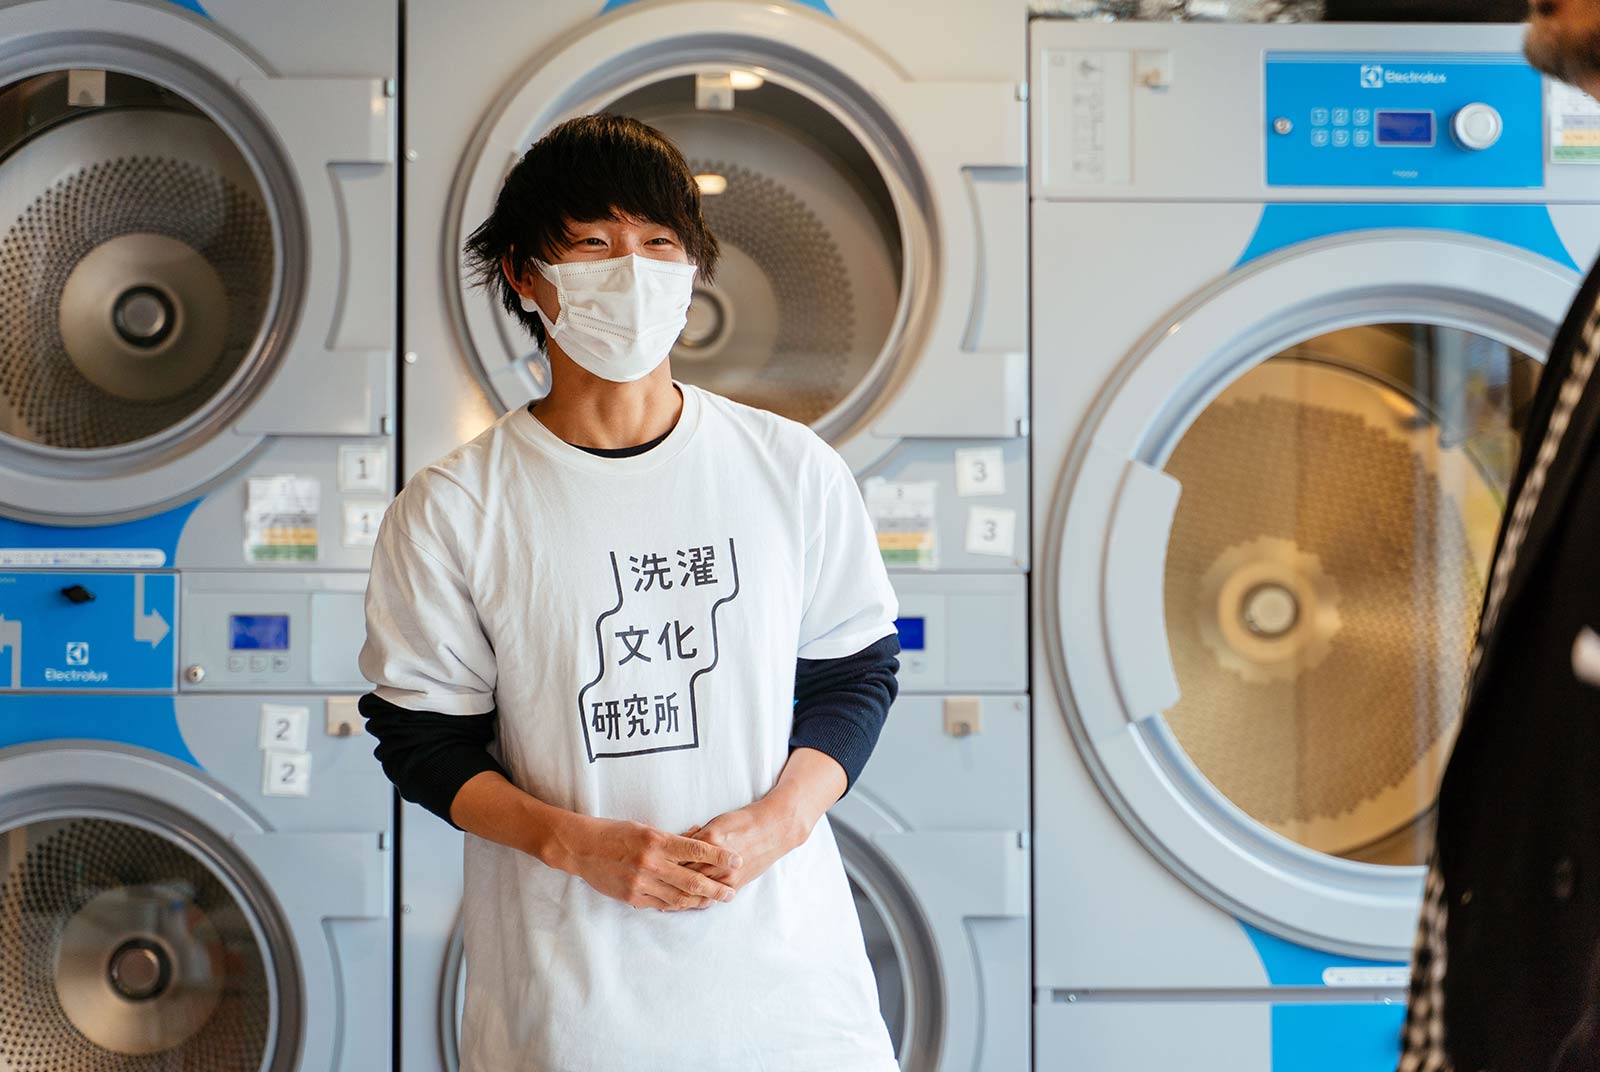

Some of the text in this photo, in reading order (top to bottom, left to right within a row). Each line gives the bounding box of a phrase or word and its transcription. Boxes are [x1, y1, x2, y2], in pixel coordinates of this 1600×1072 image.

[1385, 70, 1447, 83] Electrolux
[357, 457, 368, 480] 1
[972, 460, 988, 482] 3
[981, 519, 997, 541] 3
[628, 545, 719, 593] 洗濯
[615, 620, 697, 666] 文化
[45, 667, 108, 681] Electrolux
[591, 691, 680, 741] 研究所
[276, 718, 290, 741] 2
[281, 761, 296, 784] 2
